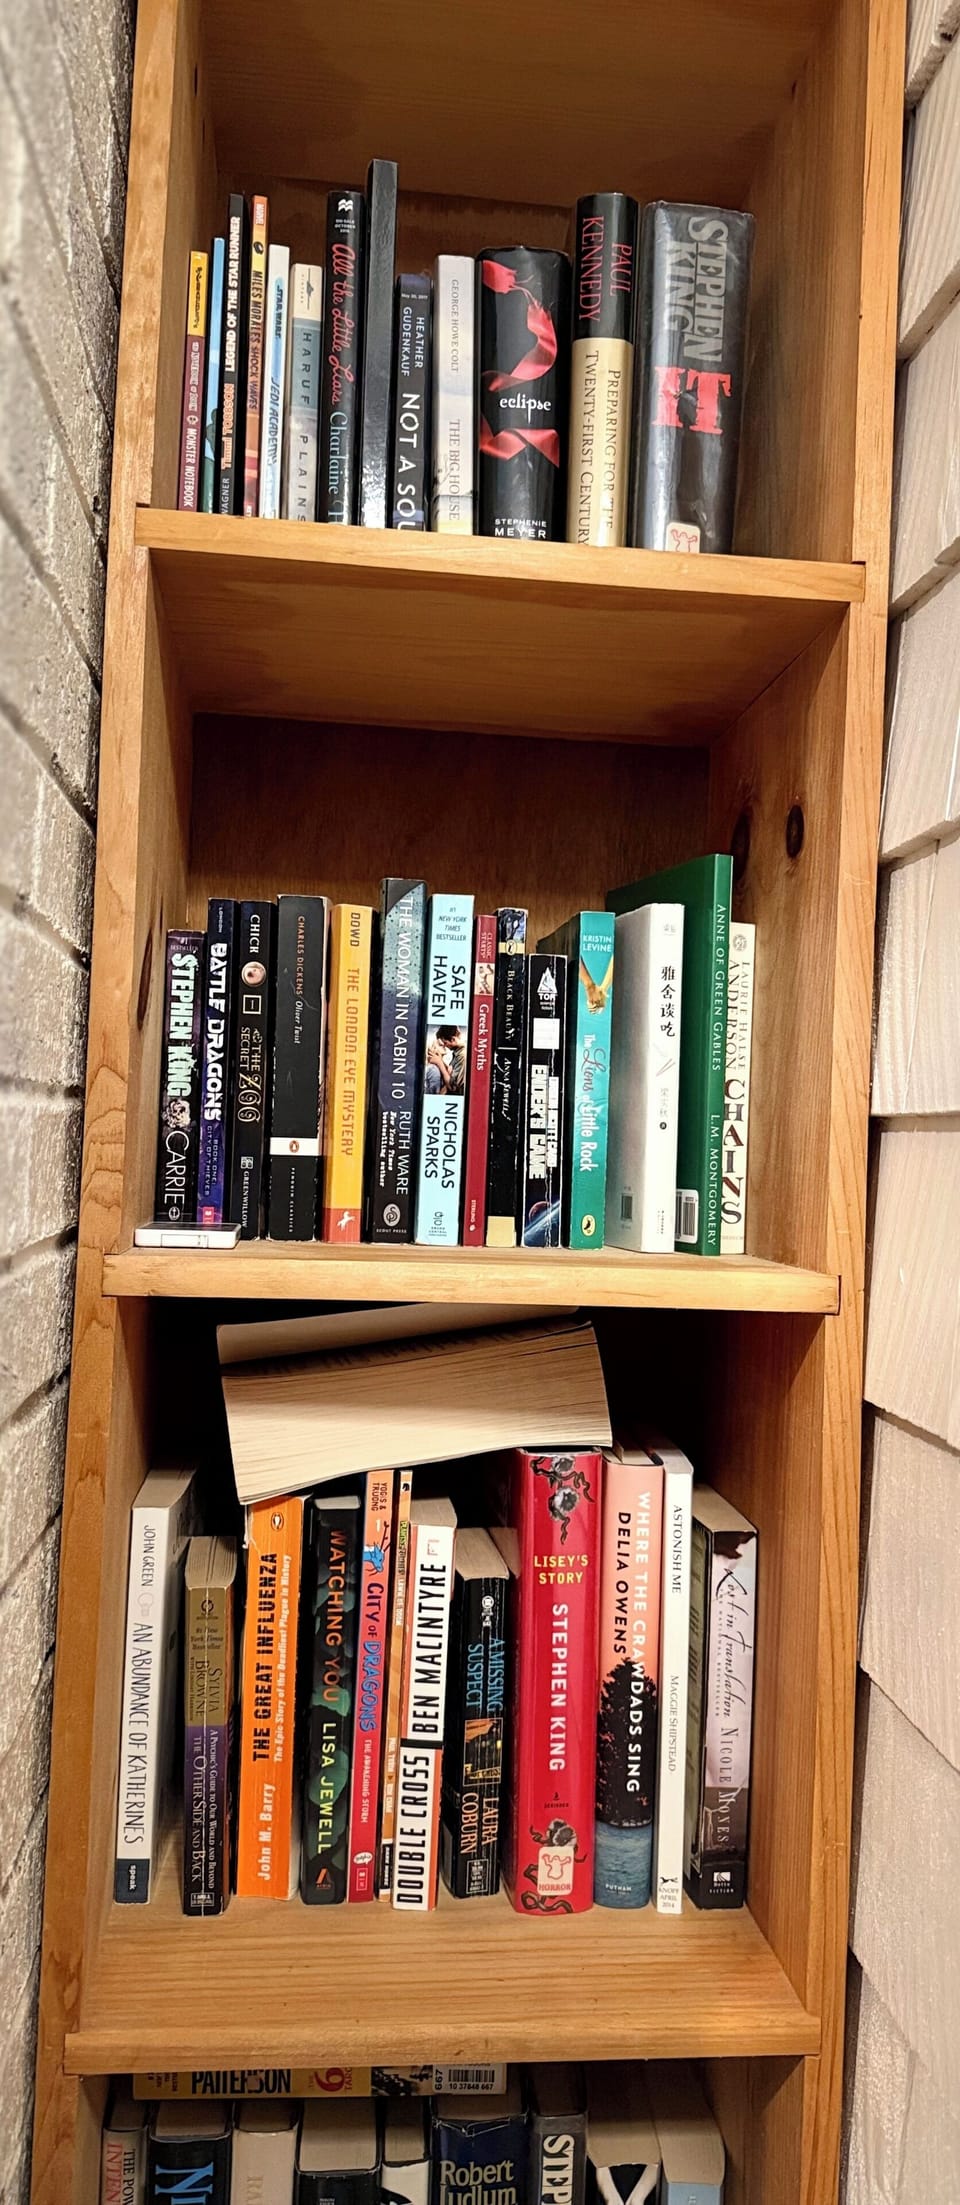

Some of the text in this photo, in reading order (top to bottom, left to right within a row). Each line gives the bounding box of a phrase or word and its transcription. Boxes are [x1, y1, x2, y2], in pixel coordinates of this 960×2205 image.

[224, 217, 240, 371] LEGEND OF THE STAR RUNNER
[578, 216, 604, 322] KENNEDY
[610, 242, 632, 297] PAUL
[664, 240, 698, 332] KING
[683, 216, 729, 362] STEPHEN
[248, 270, 262, 410] MILES MORALES SHOCK WAVES
[401, 306, 412, 377] GUDENKAUF
[414, 317, 425, 368] HEATHER
[450, 279, 459, 372] GEORGE HOWE COLT
[300, 332, 312, 406] HARUF
[651, 366, 732, 434] IT
[266, 377, 280, 466] JEDI ACADEMY
[499, 392, 552, 424] eclipse
[184, 428, 196, 507] MONSTER NOTEBOOK
[448, 420, 460, 520] THE BIG HOUSE
[494, 518, 547, 528] STEPHENIE
[494, 529, 546, 540] MEYER
[249, 914, 261, 954] CHICK
[295, 916, 306, 996] CHARLES DICKENS
[349, 912, 362, 948] DOWD
[582, 944, 612, 952] LEVINE
[391, 898, 414, 1099] THE WOMAN IN CABIN 10
[431, 955, 448, 1018] HAVEN
[450, 964, 466, 1010] SAFE
[660, 966, 676, 1037] 雅舍谈吃
[712, 904, 726, 1070] ANNE OF GREEN GABLES
[738, 962, 750, 1070] LAURIE HALSE
[166, 953, 199, 1096] STEPHEN KING
[204, 943, 228, 1121] BATTLE DRAGONS
[239, 1027, 250, 1070] SECRET
[294, 1000, 304, 1044] Oliver Twist
[474, 1003, 489, 1070] Greek Myths
[250, 1043, 262, 1072] THE
[341, 968, 360, 1156] THE LONDON EYE MYSTERY
[164, 1130, 190, 1204] CARRIE
[206, 1146, 212, 1157] OF
[378, 1112, 388, 1187] bestselling author
[387, 1149, 395, 1171] Times
[388, 1128, 396, 1146] York
[396, 1112, 412, 1196] RUTH WARE
[424, 1116, 440, 1178] SPARKS
[440, 1102, 458, 1189] NICHOLAS
[720, 1078, 746, 1224] CHAINS
[204, 1158, 212, 1196] THIEVES
[241, 1171, 250, 1228] GREENWILLOW
[708, 1115, 720, 1245] L.M. MONTGOMERY
[370, 1482, 380, 1512] TRUONG
[141, 1524, 156, 1587] JOHN GREEN
[534, 1554, 590, 1568] LISEY'S
[538, 1571, 584, 1584] STORY
[671, 1504, 682, 1594] ASTONISH ME
[322, 1530, 347, 1702] WATCHING YOU
[613, 1512, 631, 1654] DELIA OWENS
[254, 1552, 278, 1762] THE GREAT INFLUENZA
[360, 1582, 385, 1732] CITY OF DRAGONS
[410, 1564, 447, 1733] BEN MACINTYRE
[486, 1636, 505, 1712] A MISSING
[625, 1491, 651, 1792] WHERE THE CRAWDADS SING
[716, 1568, 752, 1718] Lost in Translation
[208, 1668, 222, 1712] SYLVIA
[466, 1643, 484, 1708] SUSPECT
[549, 1604, 568, 1771] STEPHEN KING
[122, 1622, 154, 1844] AN ABUNDANCE OF KATHERINES
[193, 1736, 202, 1752] THE
[210, 1736, 218, 1768] PSYCHIC'S
[666, 1674, 679, 1772] MAGGIE SHIPSTEAD
[192, 1754, 206, 1798] OTHER
[209, 1770, 218, 1792] GUIDE
[209, 1794, 216, 1802] TO
[318, 1723, 338, 1854] LISA JEWELL
[360, 1739, 372, 1823] THE AWAKENING STORM
[191, 1800, 206, 1828] SIDE
[191, 1828, 200, 1847] AND
[208, 1803, 216, 1818] OUR
[208, 1820, 216, 1843] WORLD
[257, 1784, 276, 1880] John M. Barry
[396, 1756, 430, 1904] DOUBLE CROSS
[460, 1792, 479, 1854] COBURN
[481, 1797, 498, 1846] LAURA
[127, 1864, 139, 1891] speak
[191, 1850, 204, 1882] BACK
[208, 1861, 216, 1888] BEYOND
[538, 1884, 572, 1892] HORROR
[440, 2160, 514, 2189] Robert
